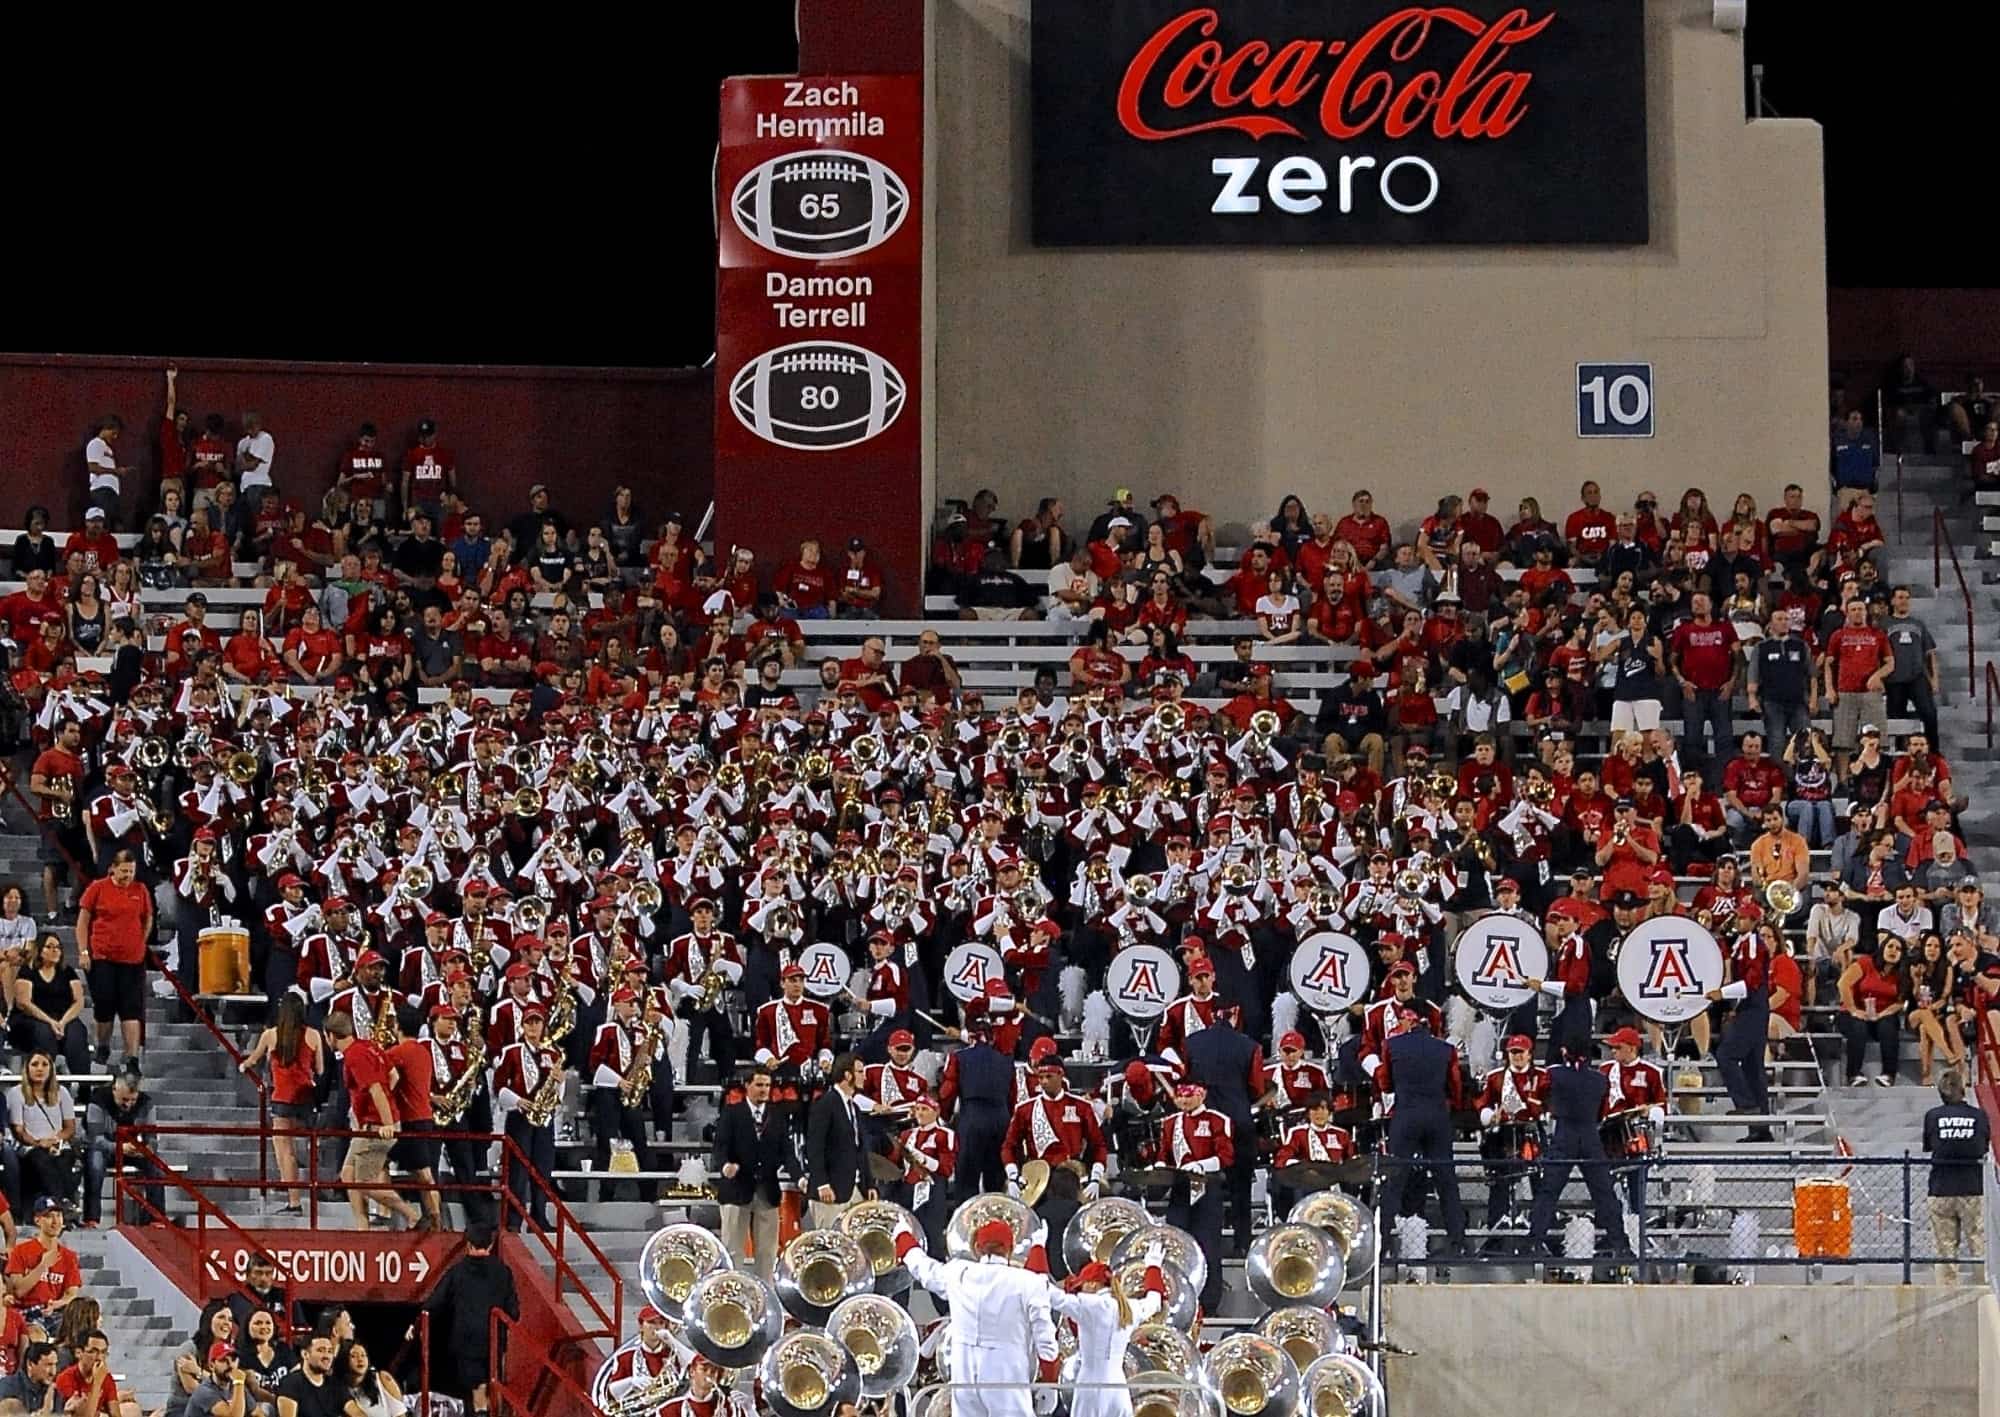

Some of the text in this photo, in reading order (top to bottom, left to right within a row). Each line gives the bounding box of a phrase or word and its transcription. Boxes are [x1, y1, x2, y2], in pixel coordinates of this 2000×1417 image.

[1116, 7, 1556, 141] Coca-Cola
[783, 81, 859, 107] Zach
[756, 113, 884, 138] Hemmila
[1211, 155, 1439, 213] zero
[800, 194, 840, 220] 65
[766, 272, 872, 297] Damon
[774, 303, 866, 327] Terrell
[800, 385, 840, 410] 80
[1581, 375, 1649, 425] 10
[416, 465, 442, 479] BEAR
[1582, 526, 1607, 539] CATS
[807, 953, 841, 985] A
[951, 953, 988, 992] A
[1301, 946, 1350, 998] A
[1472, 934, 1528, 988] A
[1639, 939, 1703, 998] A
[1120, 959, 1165, 1003] A
[1938, 1117, 1975, 1128] EVENT
[1940, 1129, 1974, 1138] STAFF
[376, 1251, 401, 1282] 10
